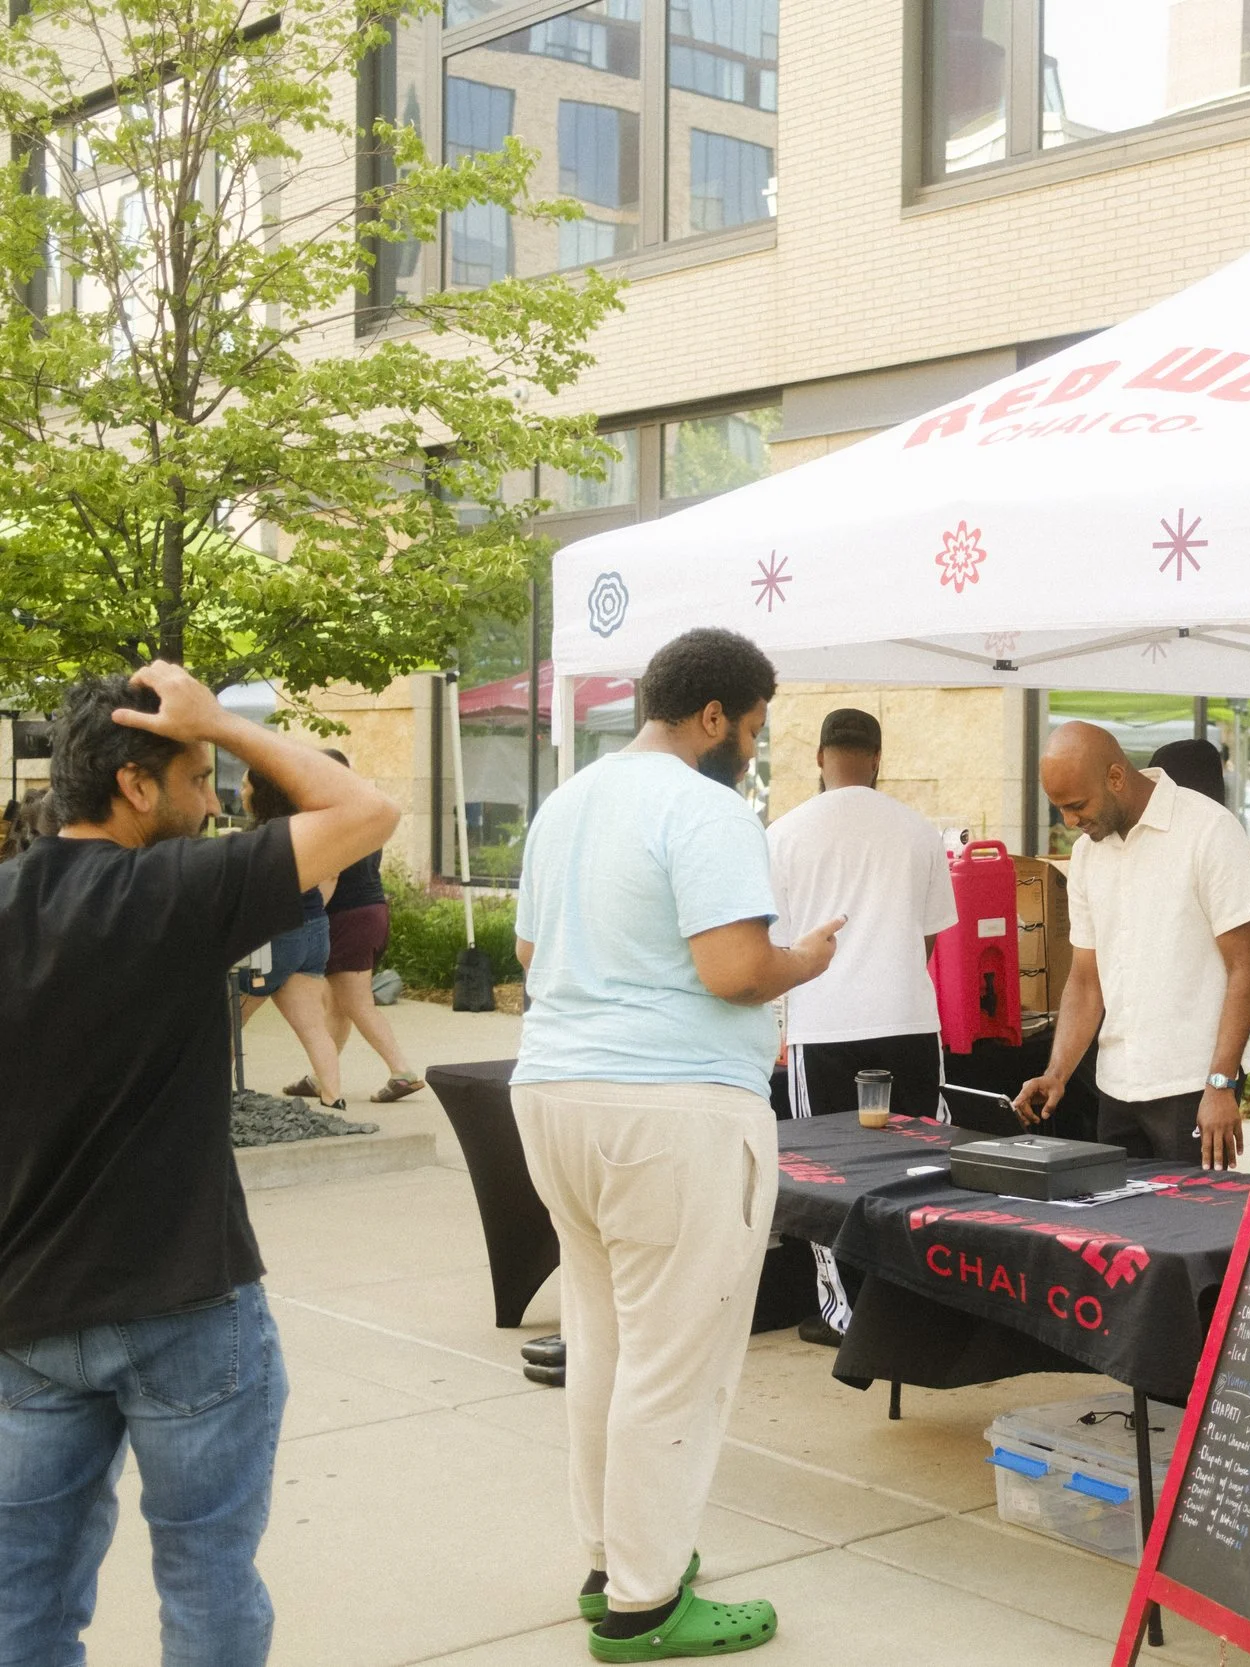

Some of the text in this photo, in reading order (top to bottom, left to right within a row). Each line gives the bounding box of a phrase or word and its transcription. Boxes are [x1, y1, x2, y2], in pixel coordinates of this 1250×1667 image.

[902, 360, 1121, 450] RED
[977, 412, 1204, 447] CHAI CO.
[926, 1244, 1110, 1337] CHAI CO.
[1230, 1343, 1248, 1362] Iced
[1211, 1399, 1241, 1424] CHAPATI
